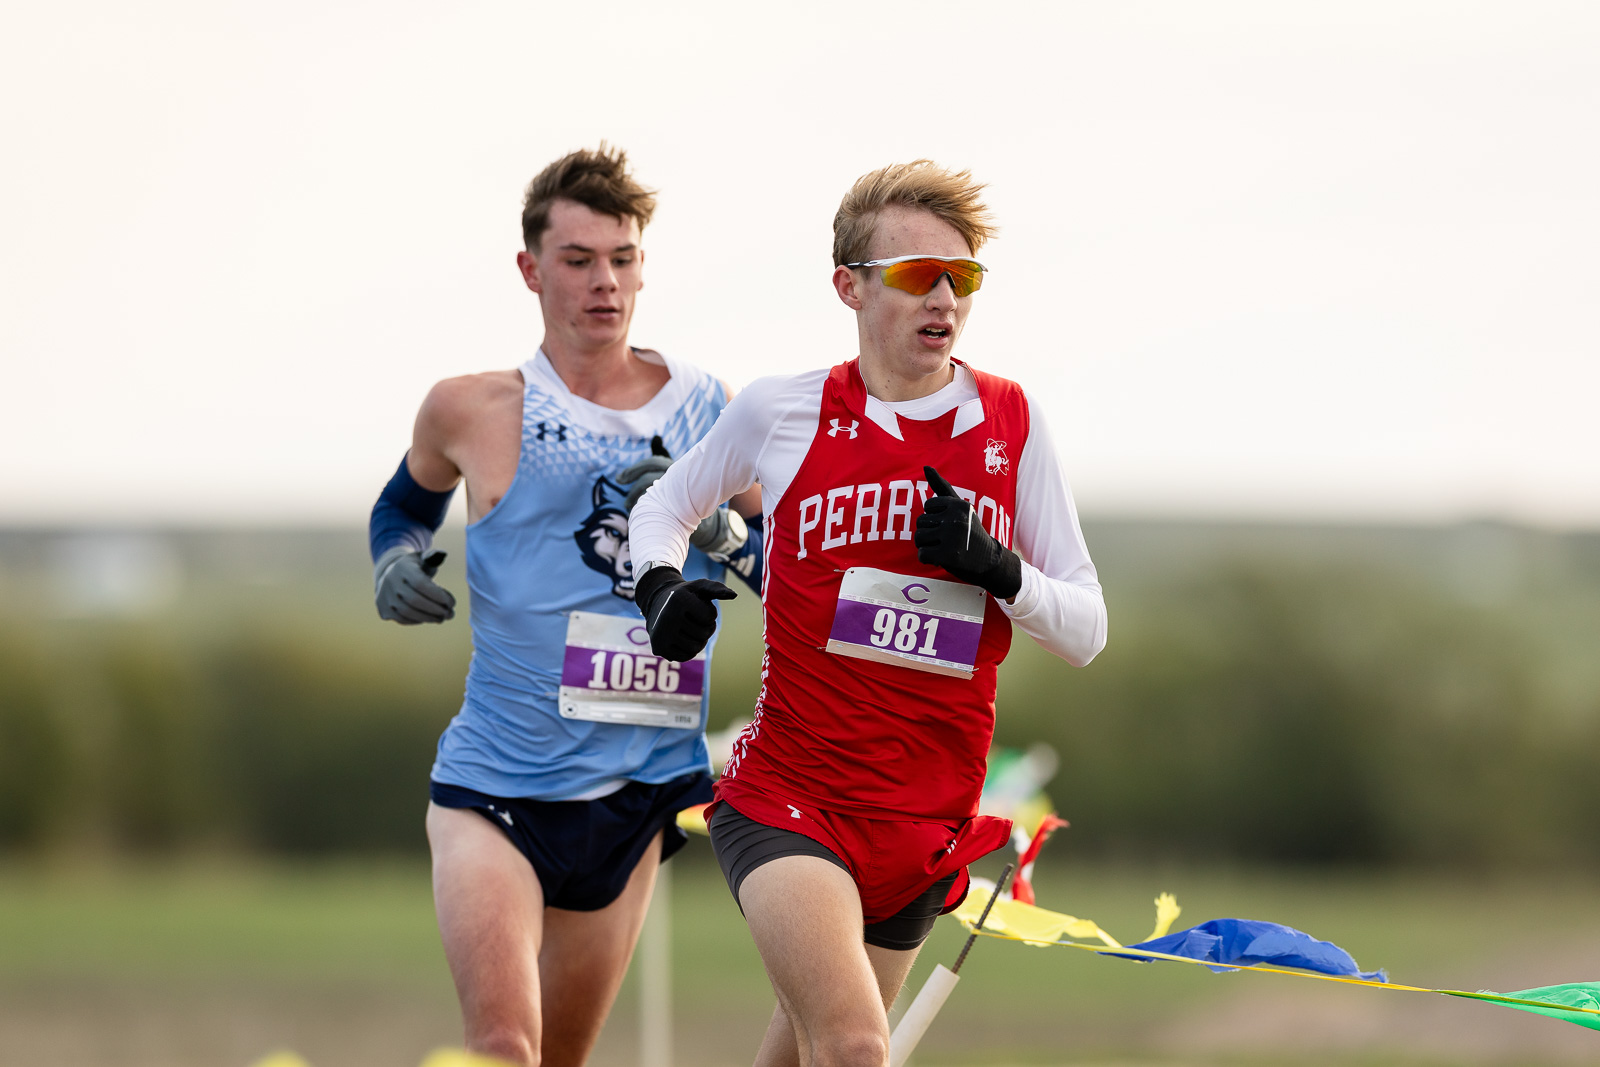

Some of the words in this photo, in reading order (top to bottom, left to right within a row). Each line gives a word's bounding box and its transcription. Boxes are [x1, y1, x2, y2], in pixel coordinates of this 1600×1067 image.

[901, 583, 931, 604] C
[870, 608, 940, 656] 981
[588, 651, 681, 693] 1056
